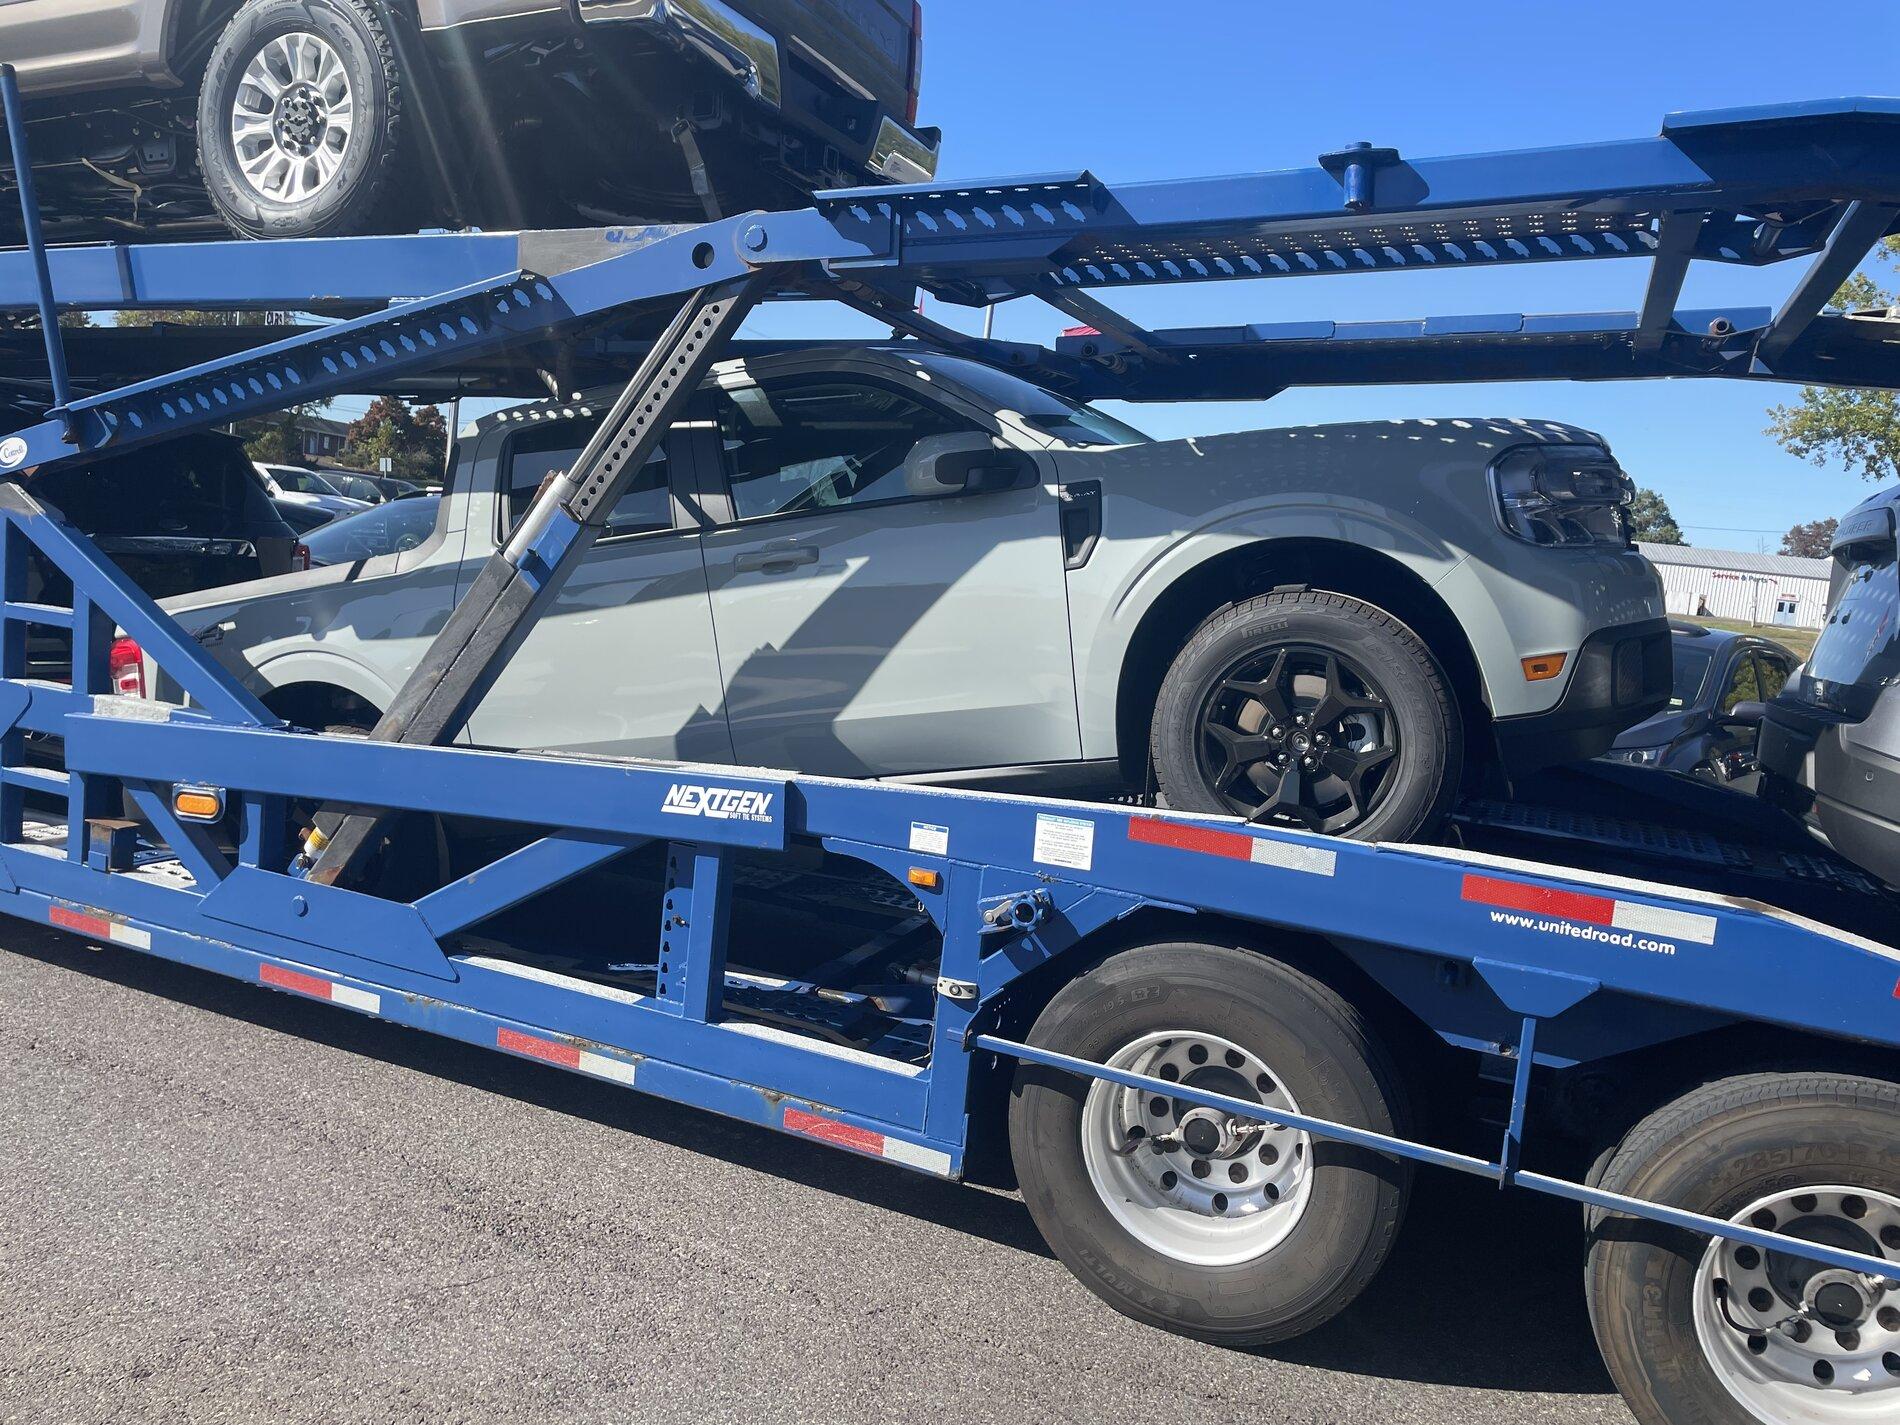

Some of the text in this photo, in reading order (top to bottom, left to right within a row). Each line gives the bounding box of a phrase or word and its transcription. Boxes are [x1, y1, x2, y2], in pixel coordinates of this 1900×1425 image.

[1712, 571, 1740, 581] Service
[1748, 575, 1768, 584] Parts
[1240, 617, 1290, 639] PIRELLI
[661, 783, 774, 819] NEXTGEN
[729, 812, 741, 820] SOFT
[751, 815, 773, 823] SYSTEMS
[1490, 911, 1676, 955] www.unitedroad.com
